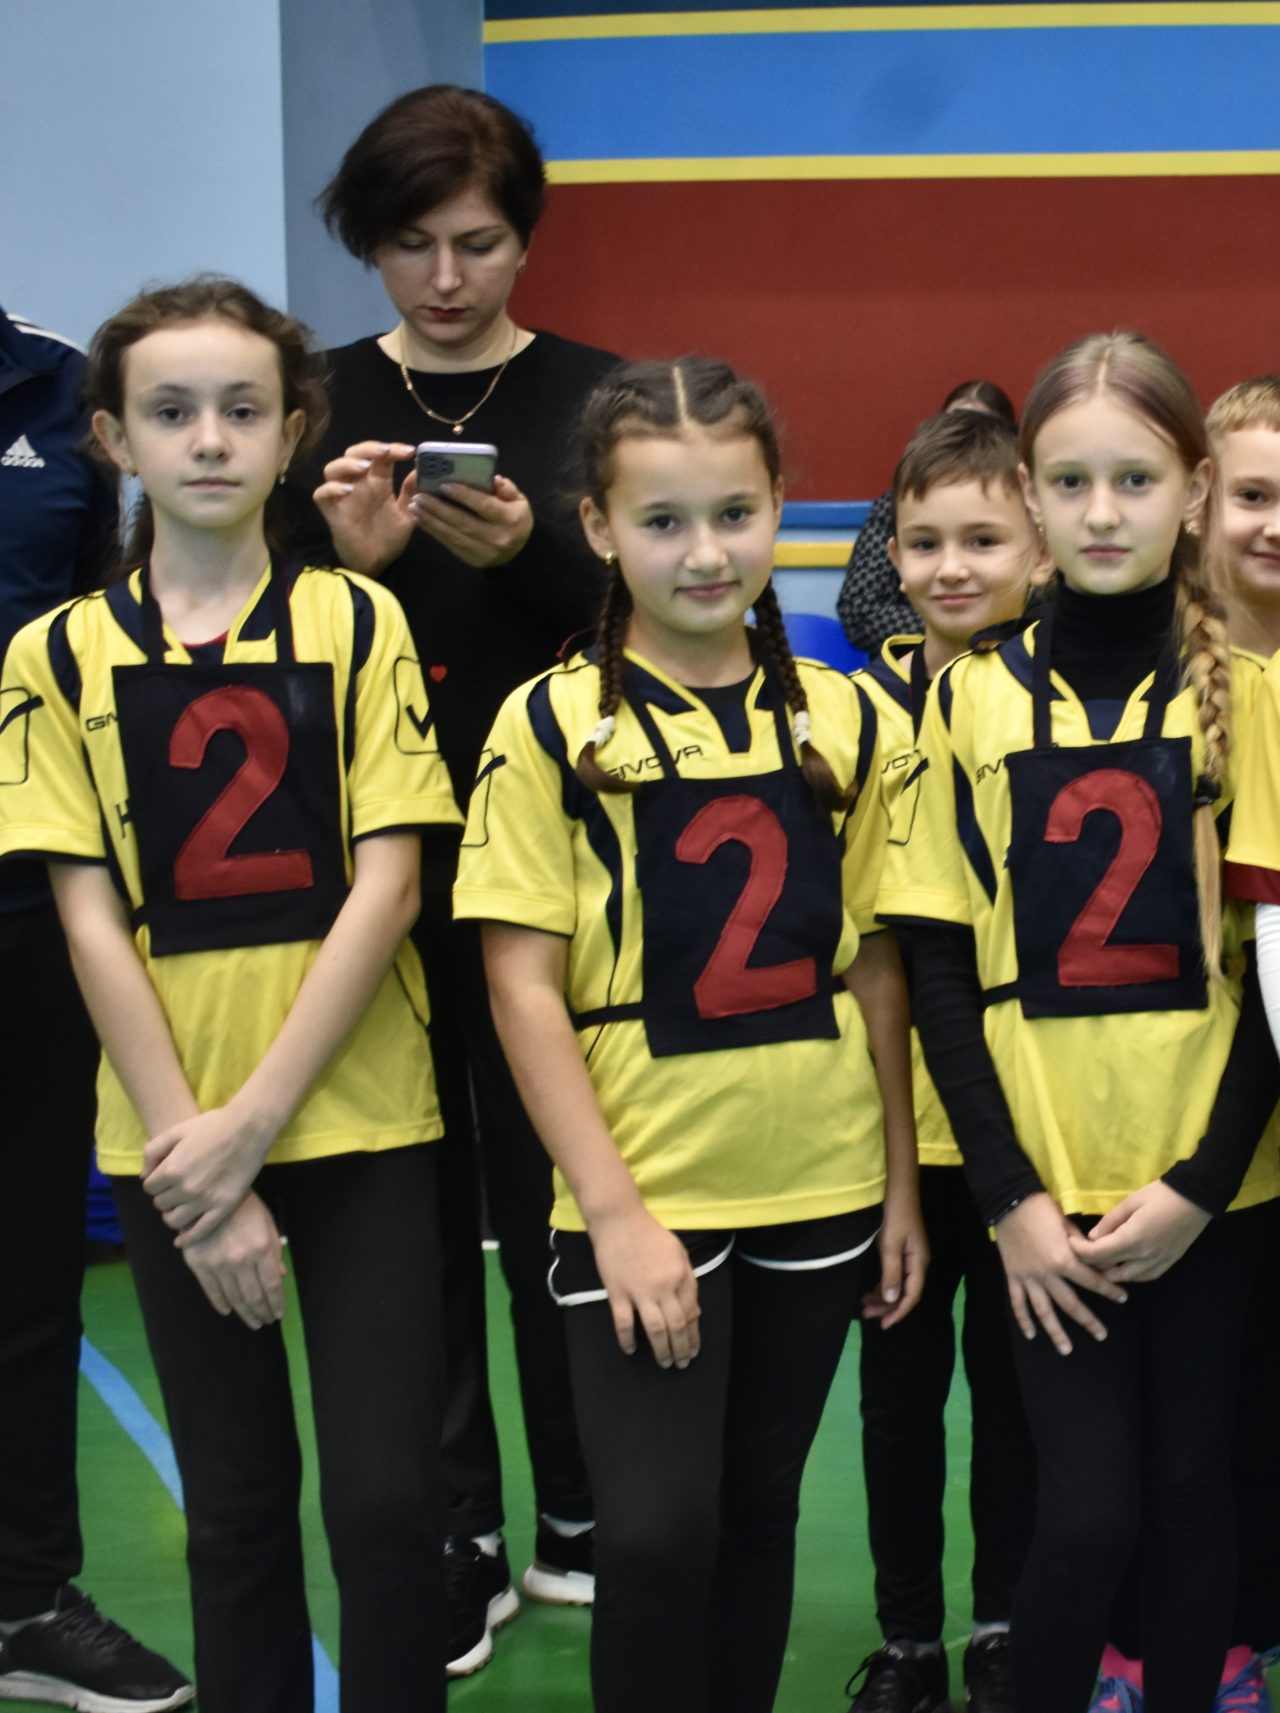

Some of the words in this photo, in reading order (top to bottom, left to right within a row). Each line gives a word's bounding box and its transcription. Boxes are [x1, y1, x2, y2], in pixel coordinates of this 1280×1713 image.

[169, 685, 314, 900] 2
[1044, 768, 1179, 987] 2
[675, 795, 817, 1019] 2
